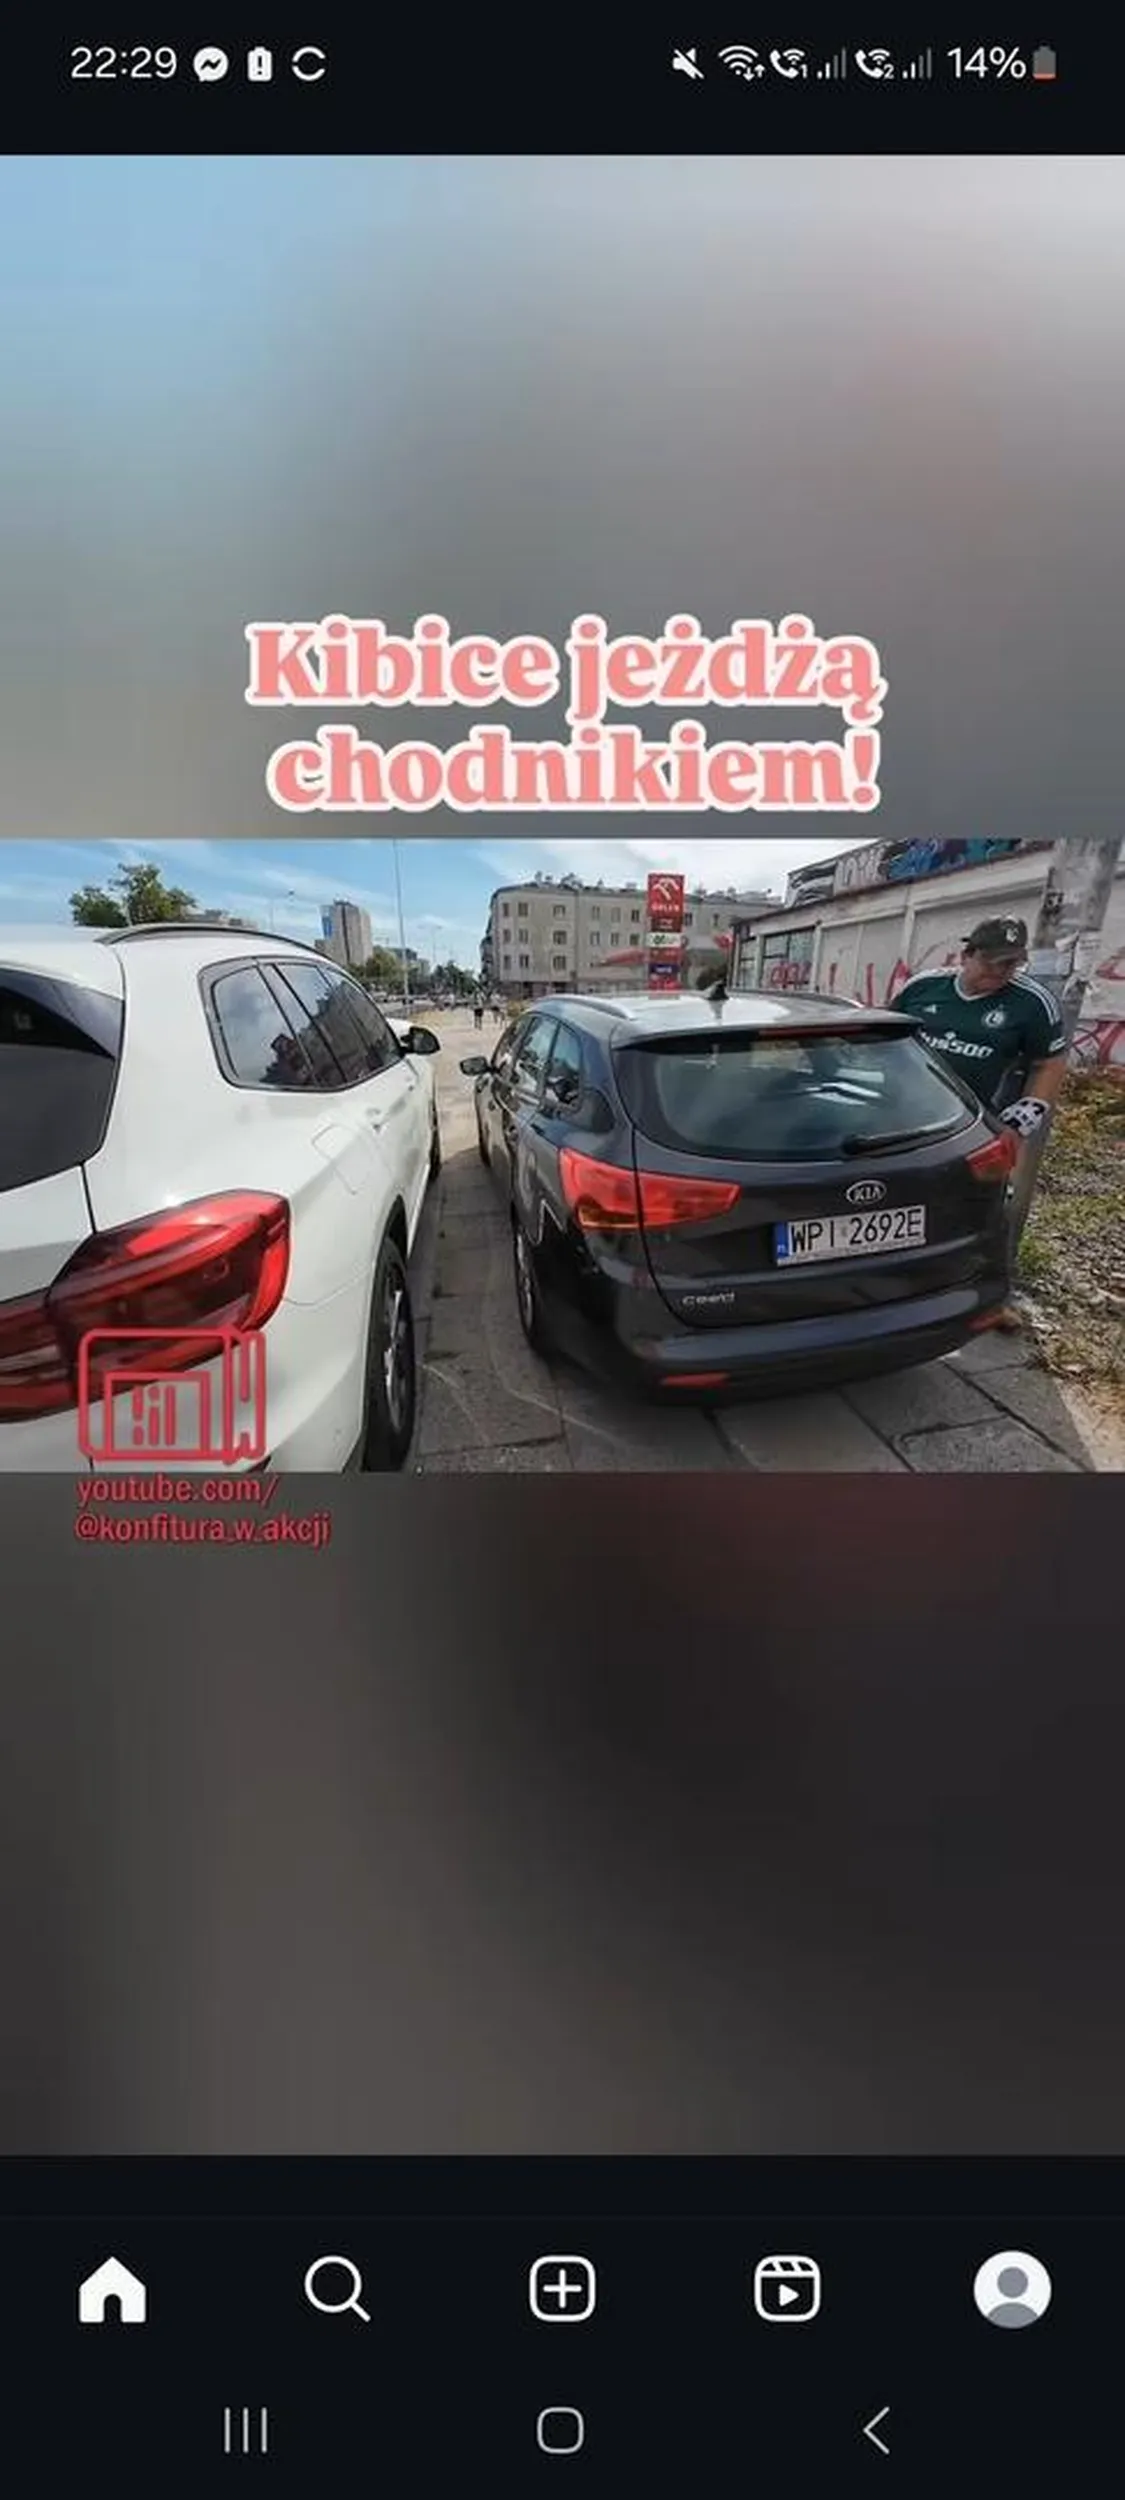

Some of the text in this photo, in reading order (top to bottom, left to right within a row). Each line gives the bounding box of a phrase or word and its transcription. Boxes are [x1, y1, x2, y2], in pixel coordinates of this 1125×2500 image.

[70, 46, 178, 78] 22:29
[946, 46, 1027, 78] 14%
[852, 1186, 883, 1201] KIA
[791, 1208, 922, 1253] WPI 2692E
